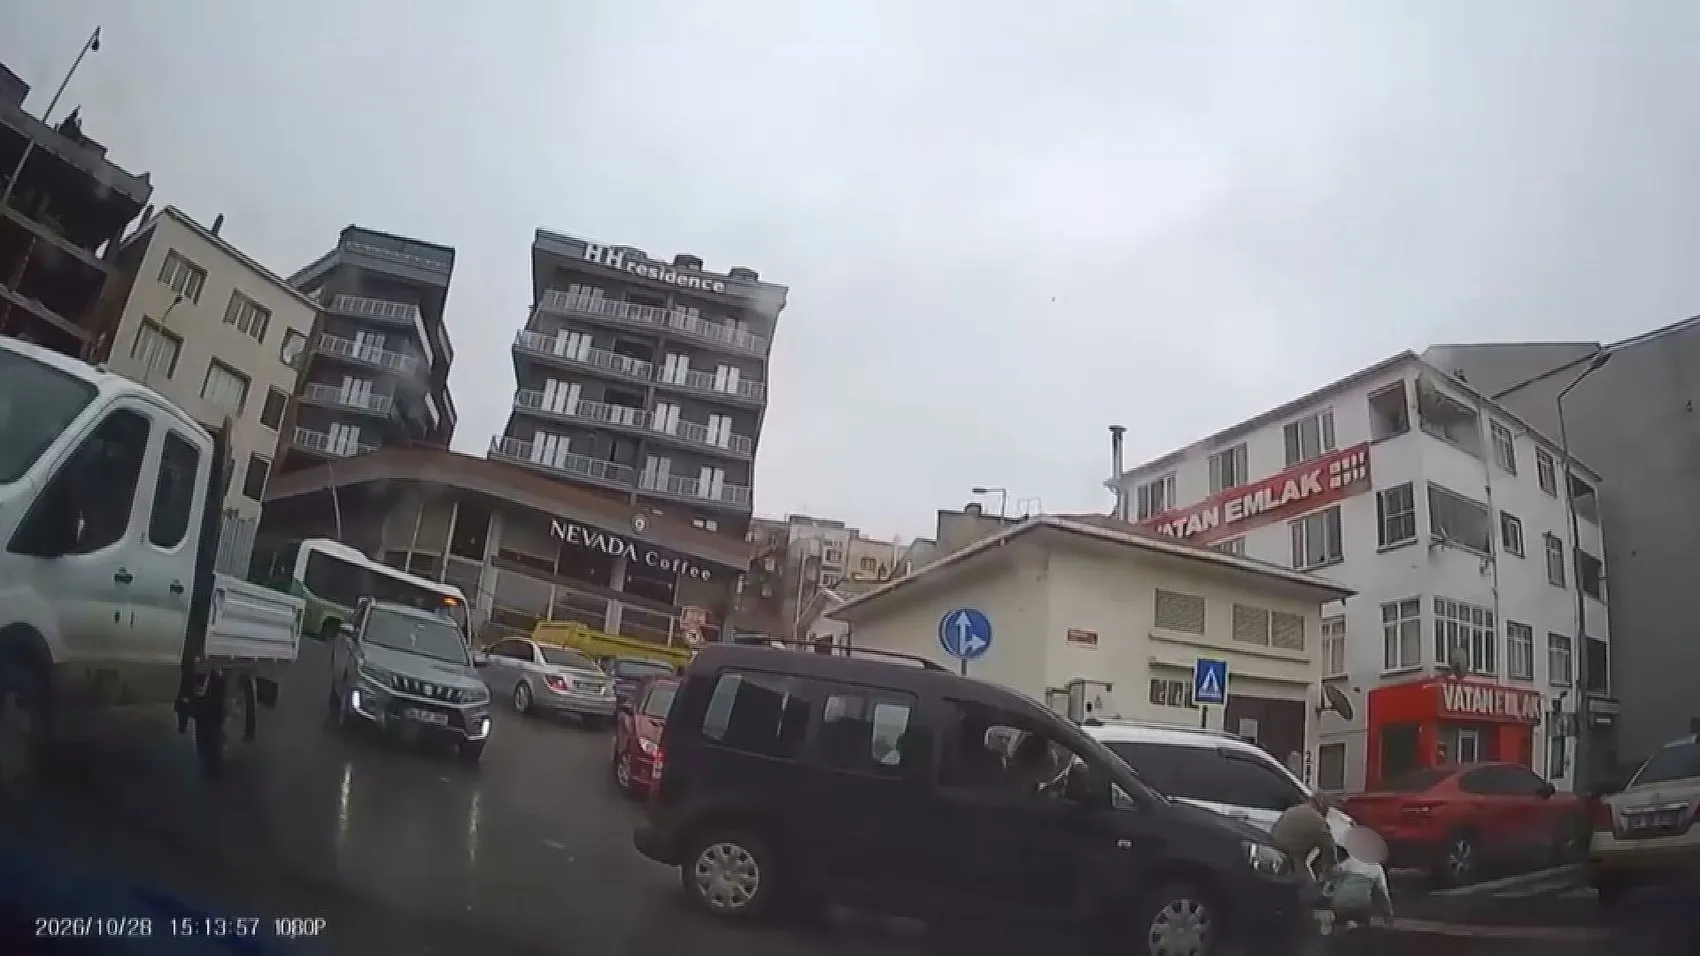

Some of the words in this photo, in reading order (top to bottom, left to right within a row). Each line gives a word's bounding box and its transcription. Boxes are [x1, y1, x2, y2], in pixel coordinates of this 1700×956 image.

[627, 261, 725, 294] residence
[1224, 469, 1322, 523] EMLAK
[551, 518, 638, 563] NEVADA
[645, 551, 711, 582] Coffee
[1443, 683, 1494, 713] VATAN
